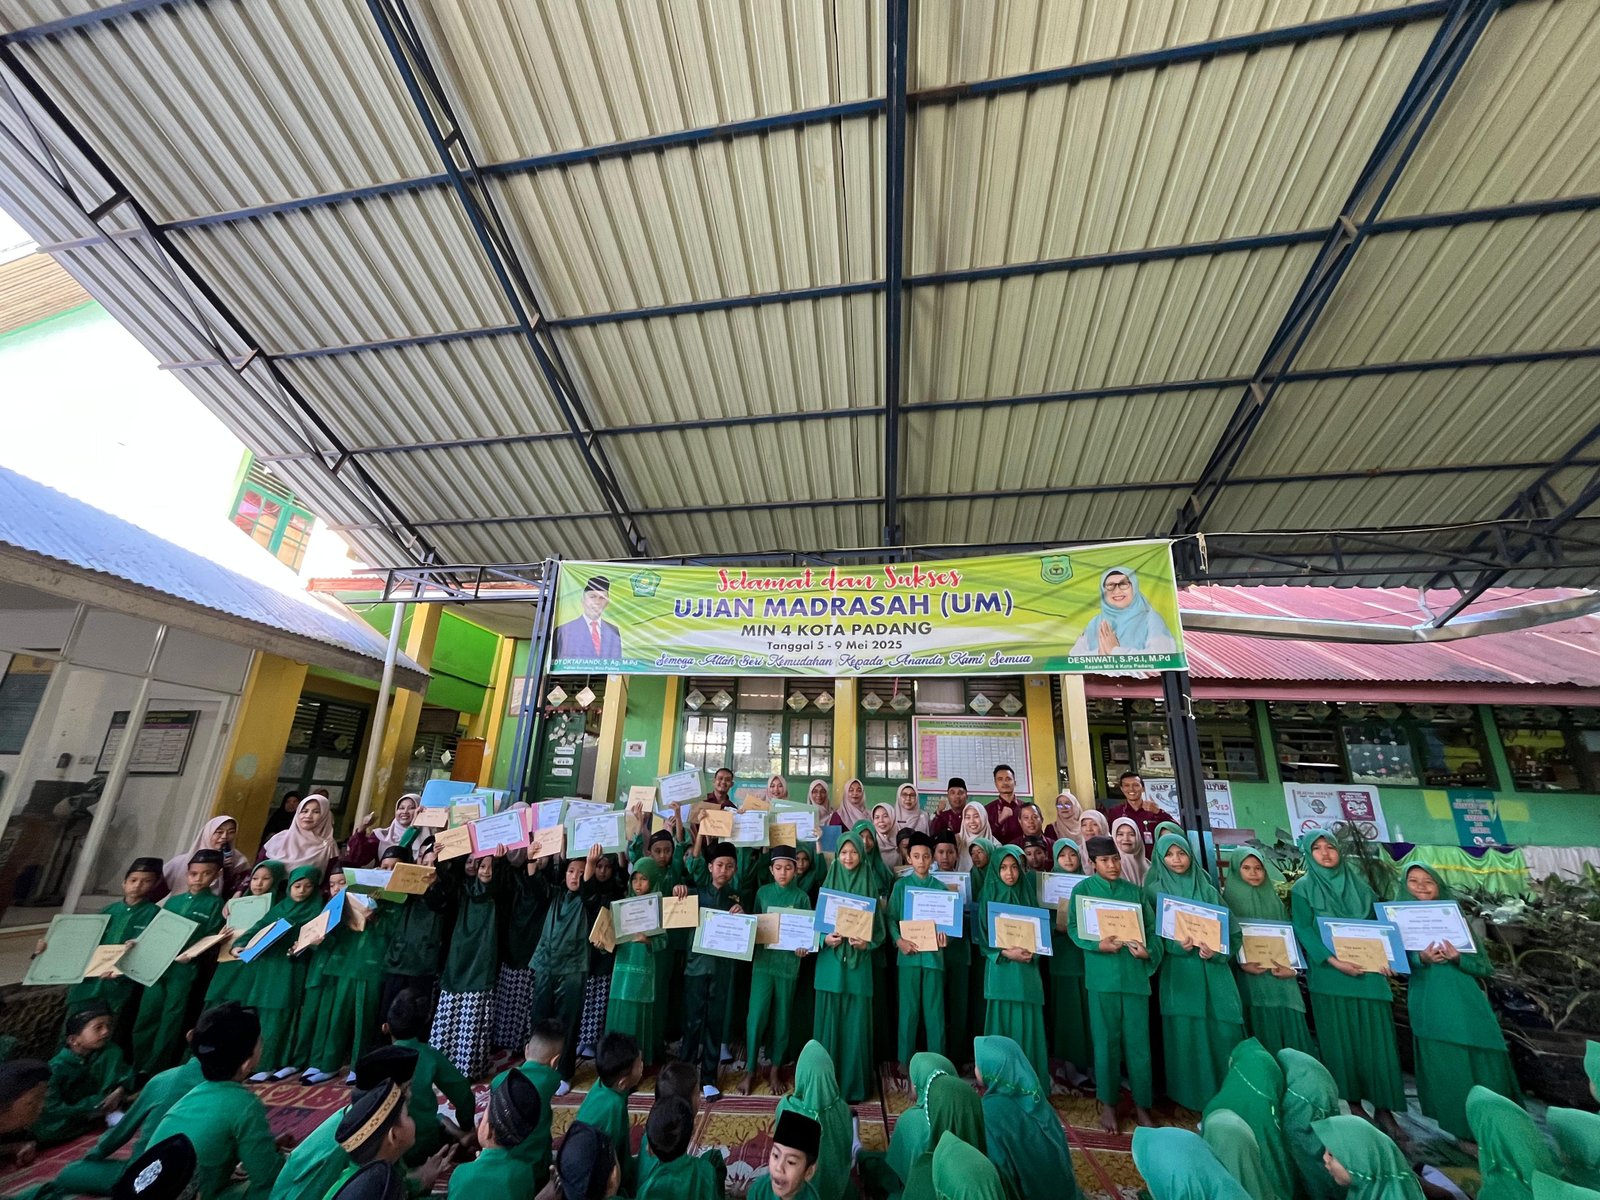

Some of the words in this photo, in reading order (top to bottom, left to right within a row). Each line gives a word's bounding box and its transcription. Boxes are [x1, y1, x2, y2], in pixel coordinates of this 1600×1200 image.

[718, 568, 814, 591] Selamat
[821, 567, 877, 590] dan
[884, 565, 962, 588] Sukses
[674, 598, 754, 618] UJIAN
[763, 595, 930, 617] MADRASAH
[940, 590, 1013, 618] (UM)
[741, 624, 776, 637] MIN
[781, 625, 792, 636] 4
[797, 624, 845, 636] KOTA
[852, 622, 932, 635] PADANG
[767, 641, 814, 652] Tanggal
[817, 641, 824, 650] 5
[835, 641, 842, 650] 9
[846, 640, 868, 650] Mei
[872, 640, 903, 649] 2025
[656, 653, 694, 669] Semoga
[700, 654, 735, 667] Allah
[739, 654, 763, 667] Beri
[768, 654, 833, 667] Kemudahan
[839, 653, 884, 669] Kepada
[889, 653, 944, 665] Ananda
[949, 653, 984, 665] Kami
[989, 652, 1031, 665] Semua
[1067, 656, 1117, 664] DESNIWATI,
[1148, 654, 1171, 662] M.Pd
